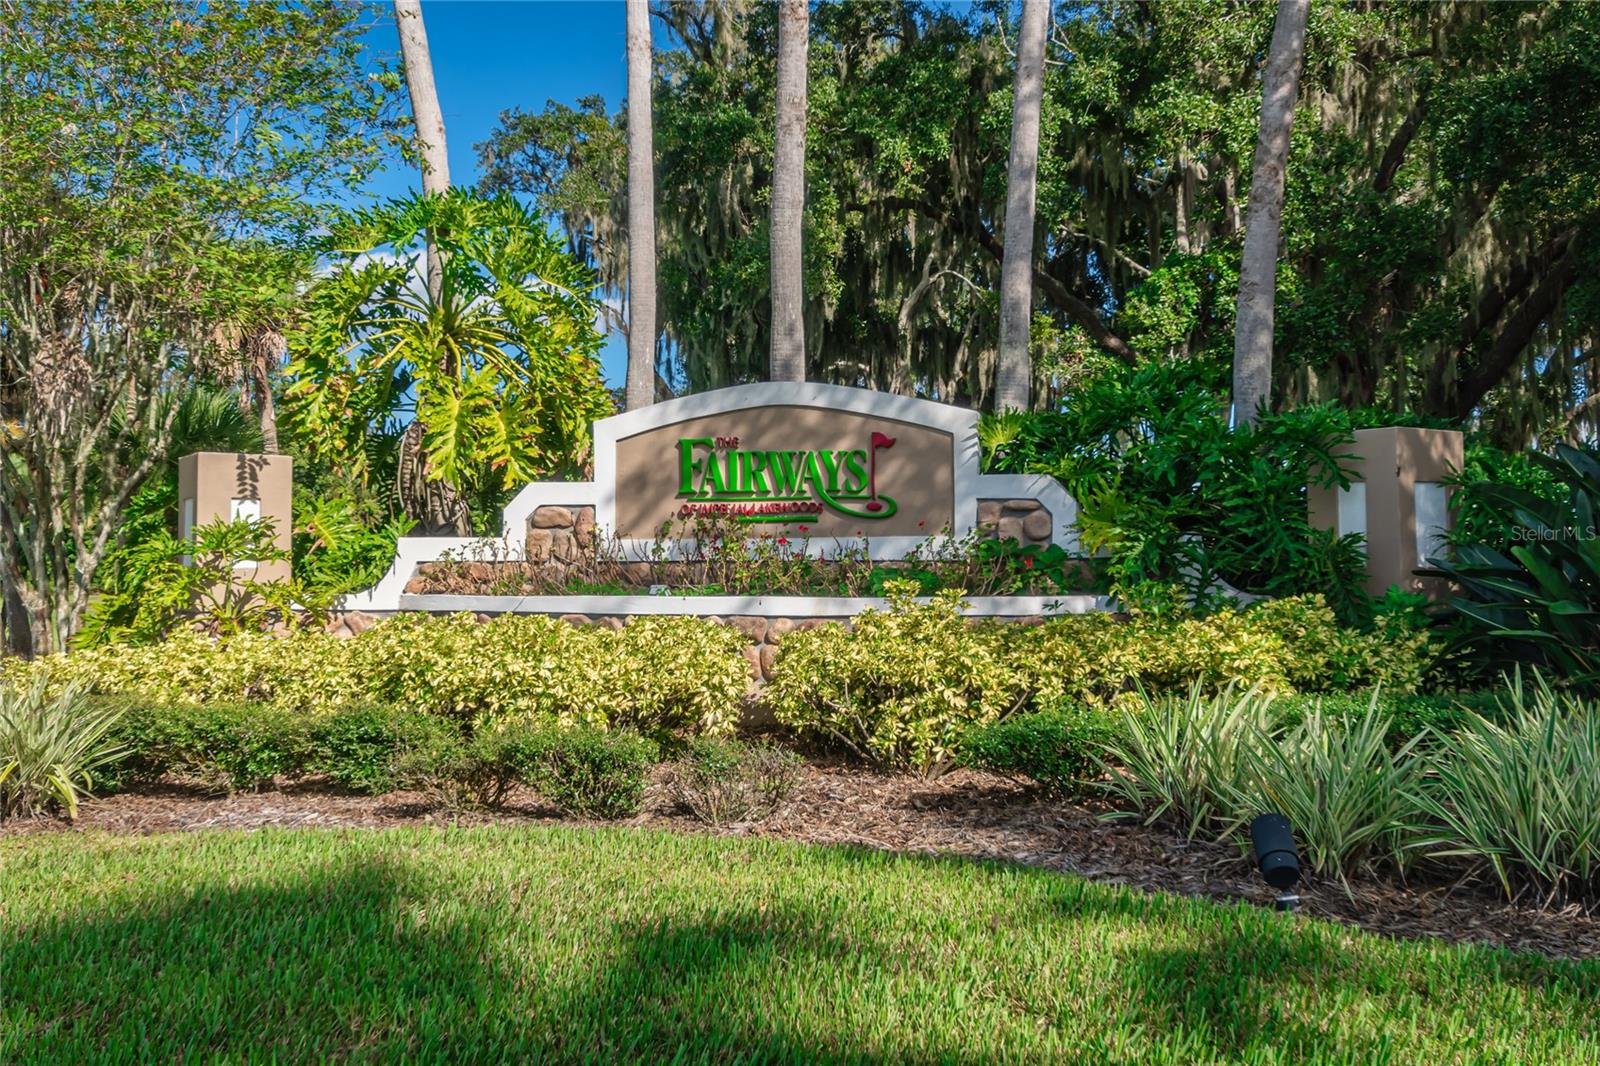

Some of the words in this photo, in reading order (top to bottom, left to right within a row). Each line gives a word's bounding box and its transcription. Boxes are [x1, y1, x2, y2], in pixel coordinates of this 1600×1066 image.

[716, 437, 739, 449] THE
[679, 438, 867, 494] FAIRWAYS
[681, 504, 697, 514] OF
